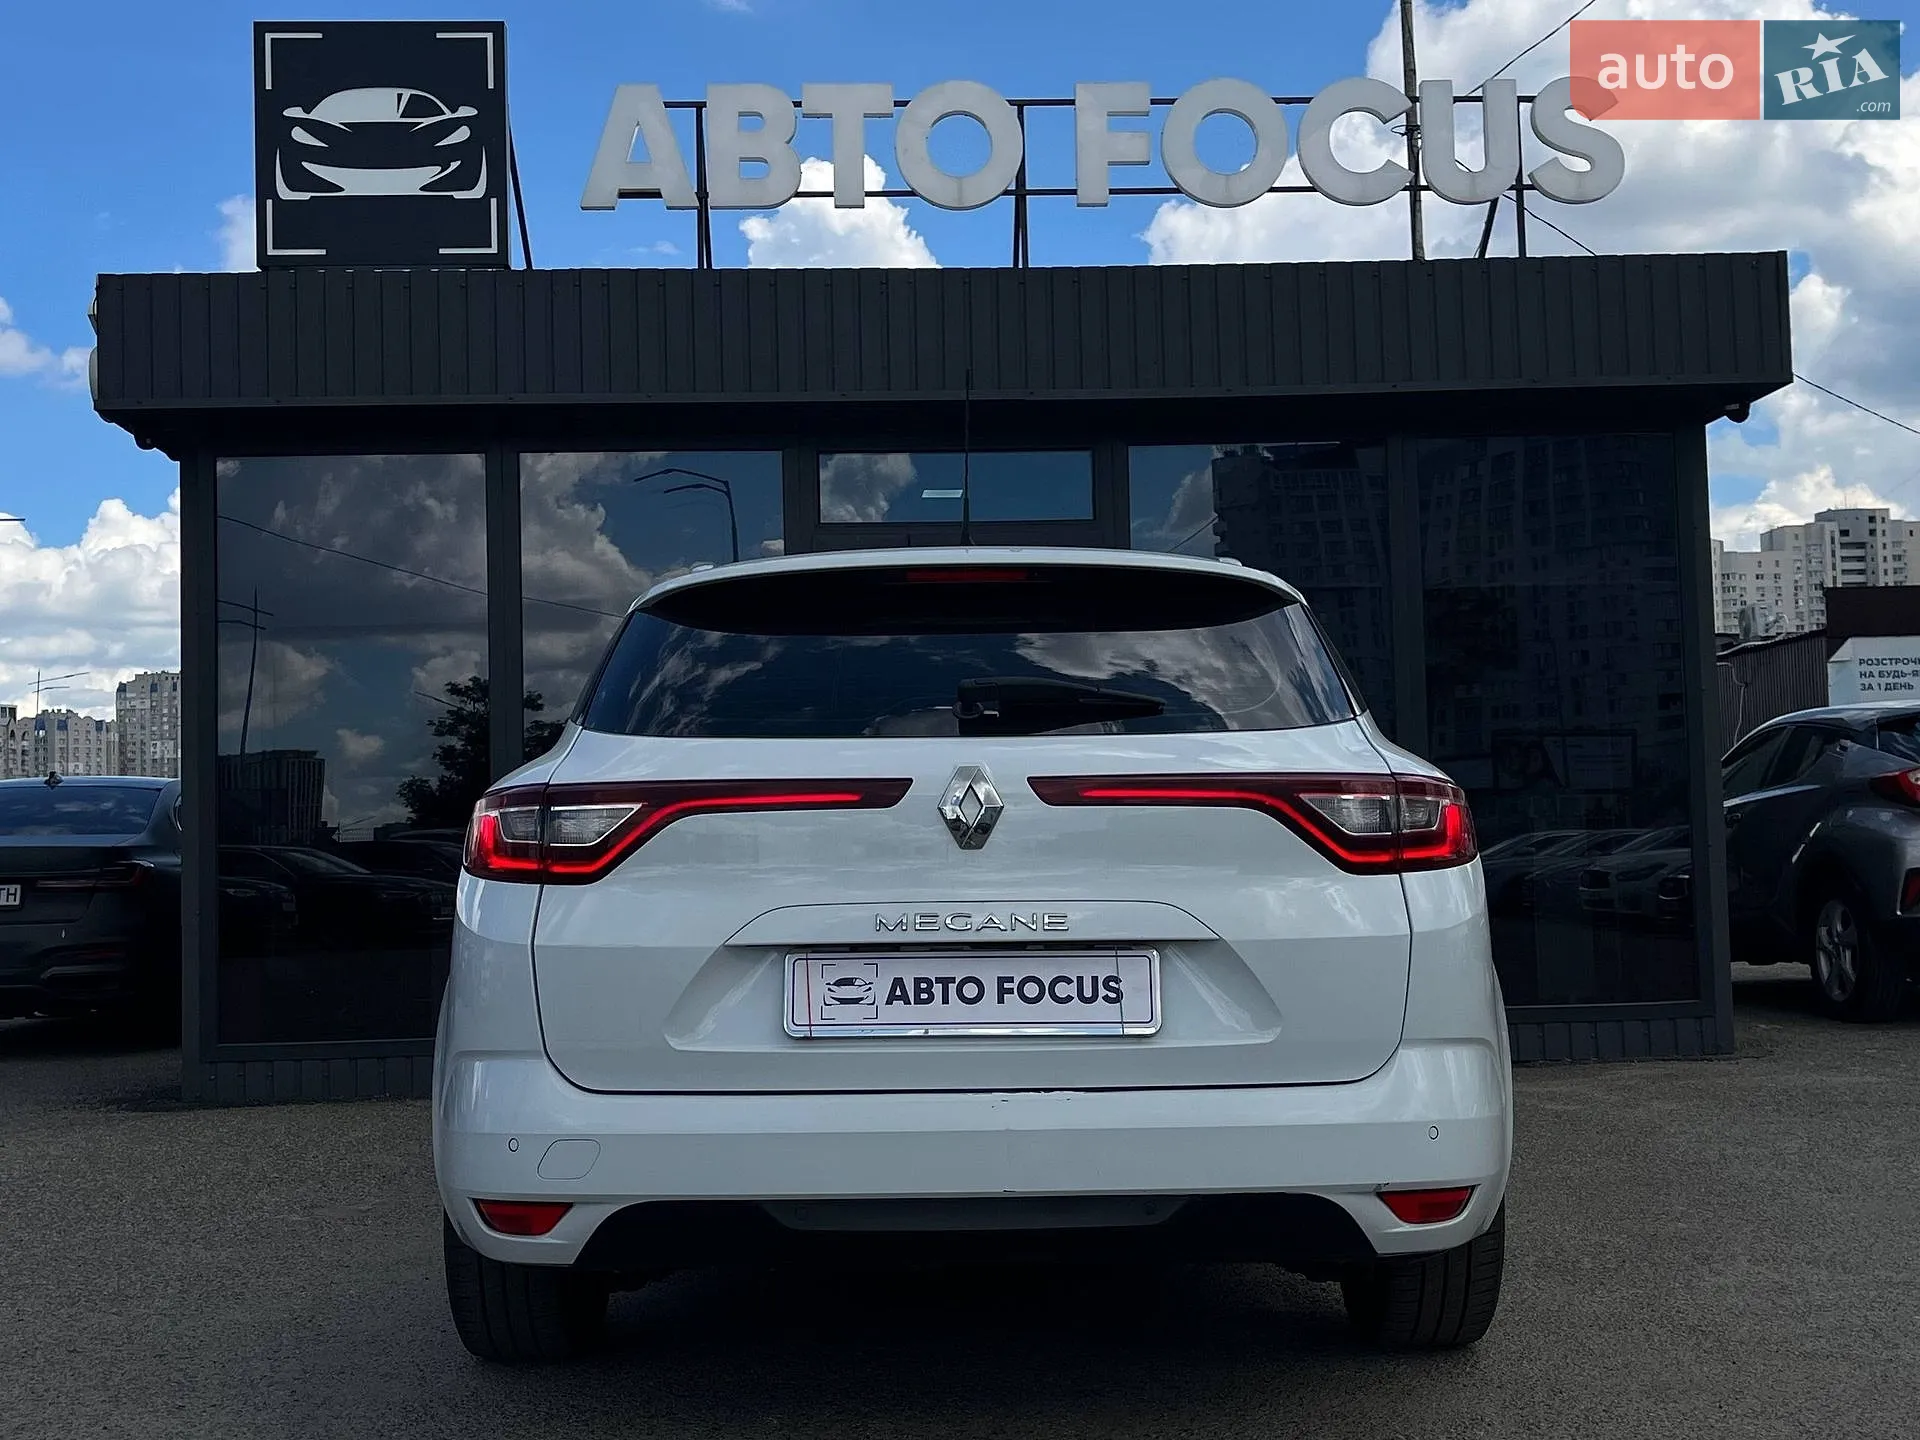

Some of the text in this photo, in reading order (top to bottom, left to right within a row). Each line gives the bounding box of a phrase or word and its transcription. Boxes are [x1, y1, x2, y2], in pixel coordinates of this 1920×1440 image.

[1075, 76, 1625, 207] FOCUS
[1860, 670, 1875, 679] НА
[1860, 682, 1914, 692] ЗА 1 ДЕНЬ
[874, 912, 1070, 932] MEGANE
[996, 975, 1124, 1005] FOCUS
